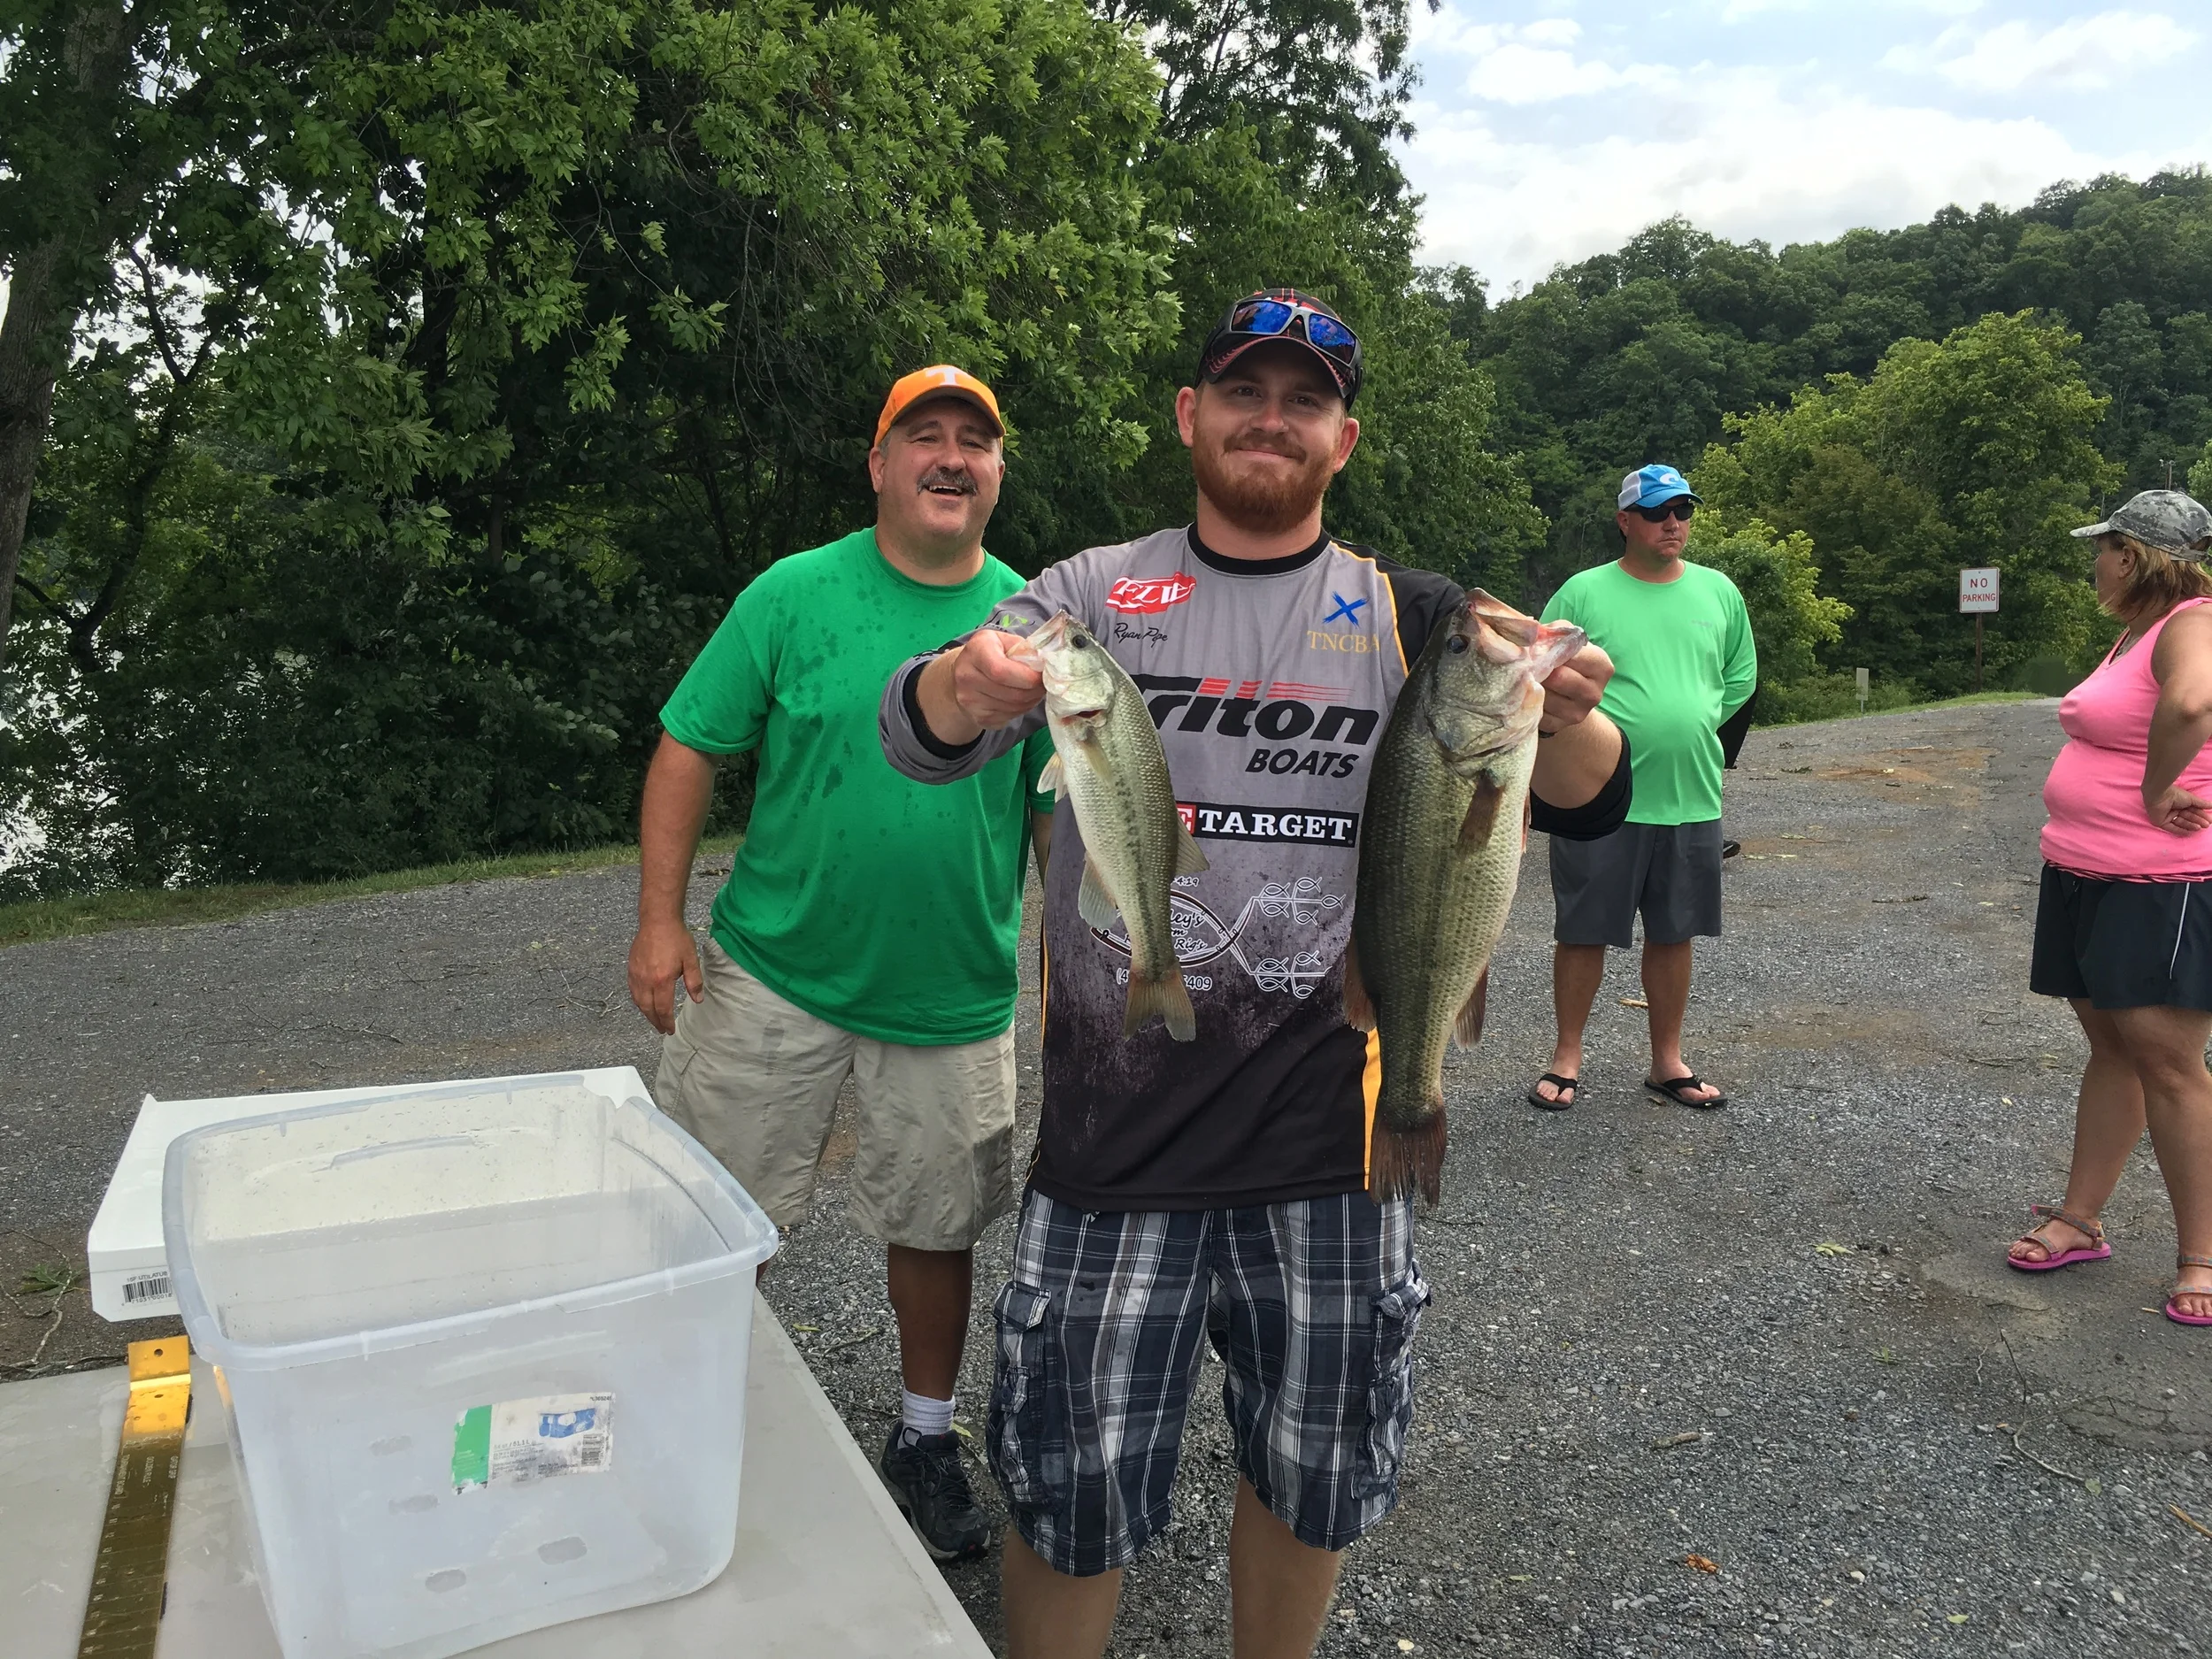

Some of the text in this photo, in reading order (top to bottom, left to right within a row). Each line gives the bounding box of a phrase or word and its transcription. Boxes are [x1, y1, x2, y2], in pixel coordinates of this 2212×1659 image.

[1112, 581, 1191, 605] FLW
[1970, 578, 1988, 588] NO
[1962, 593, 1996, 603] PARKING
[1114, 622, 1142, 644] Ryan
[1307, 630, 1380, 653] TNCBA
[1245, 748, 1360, 779] BOATS
